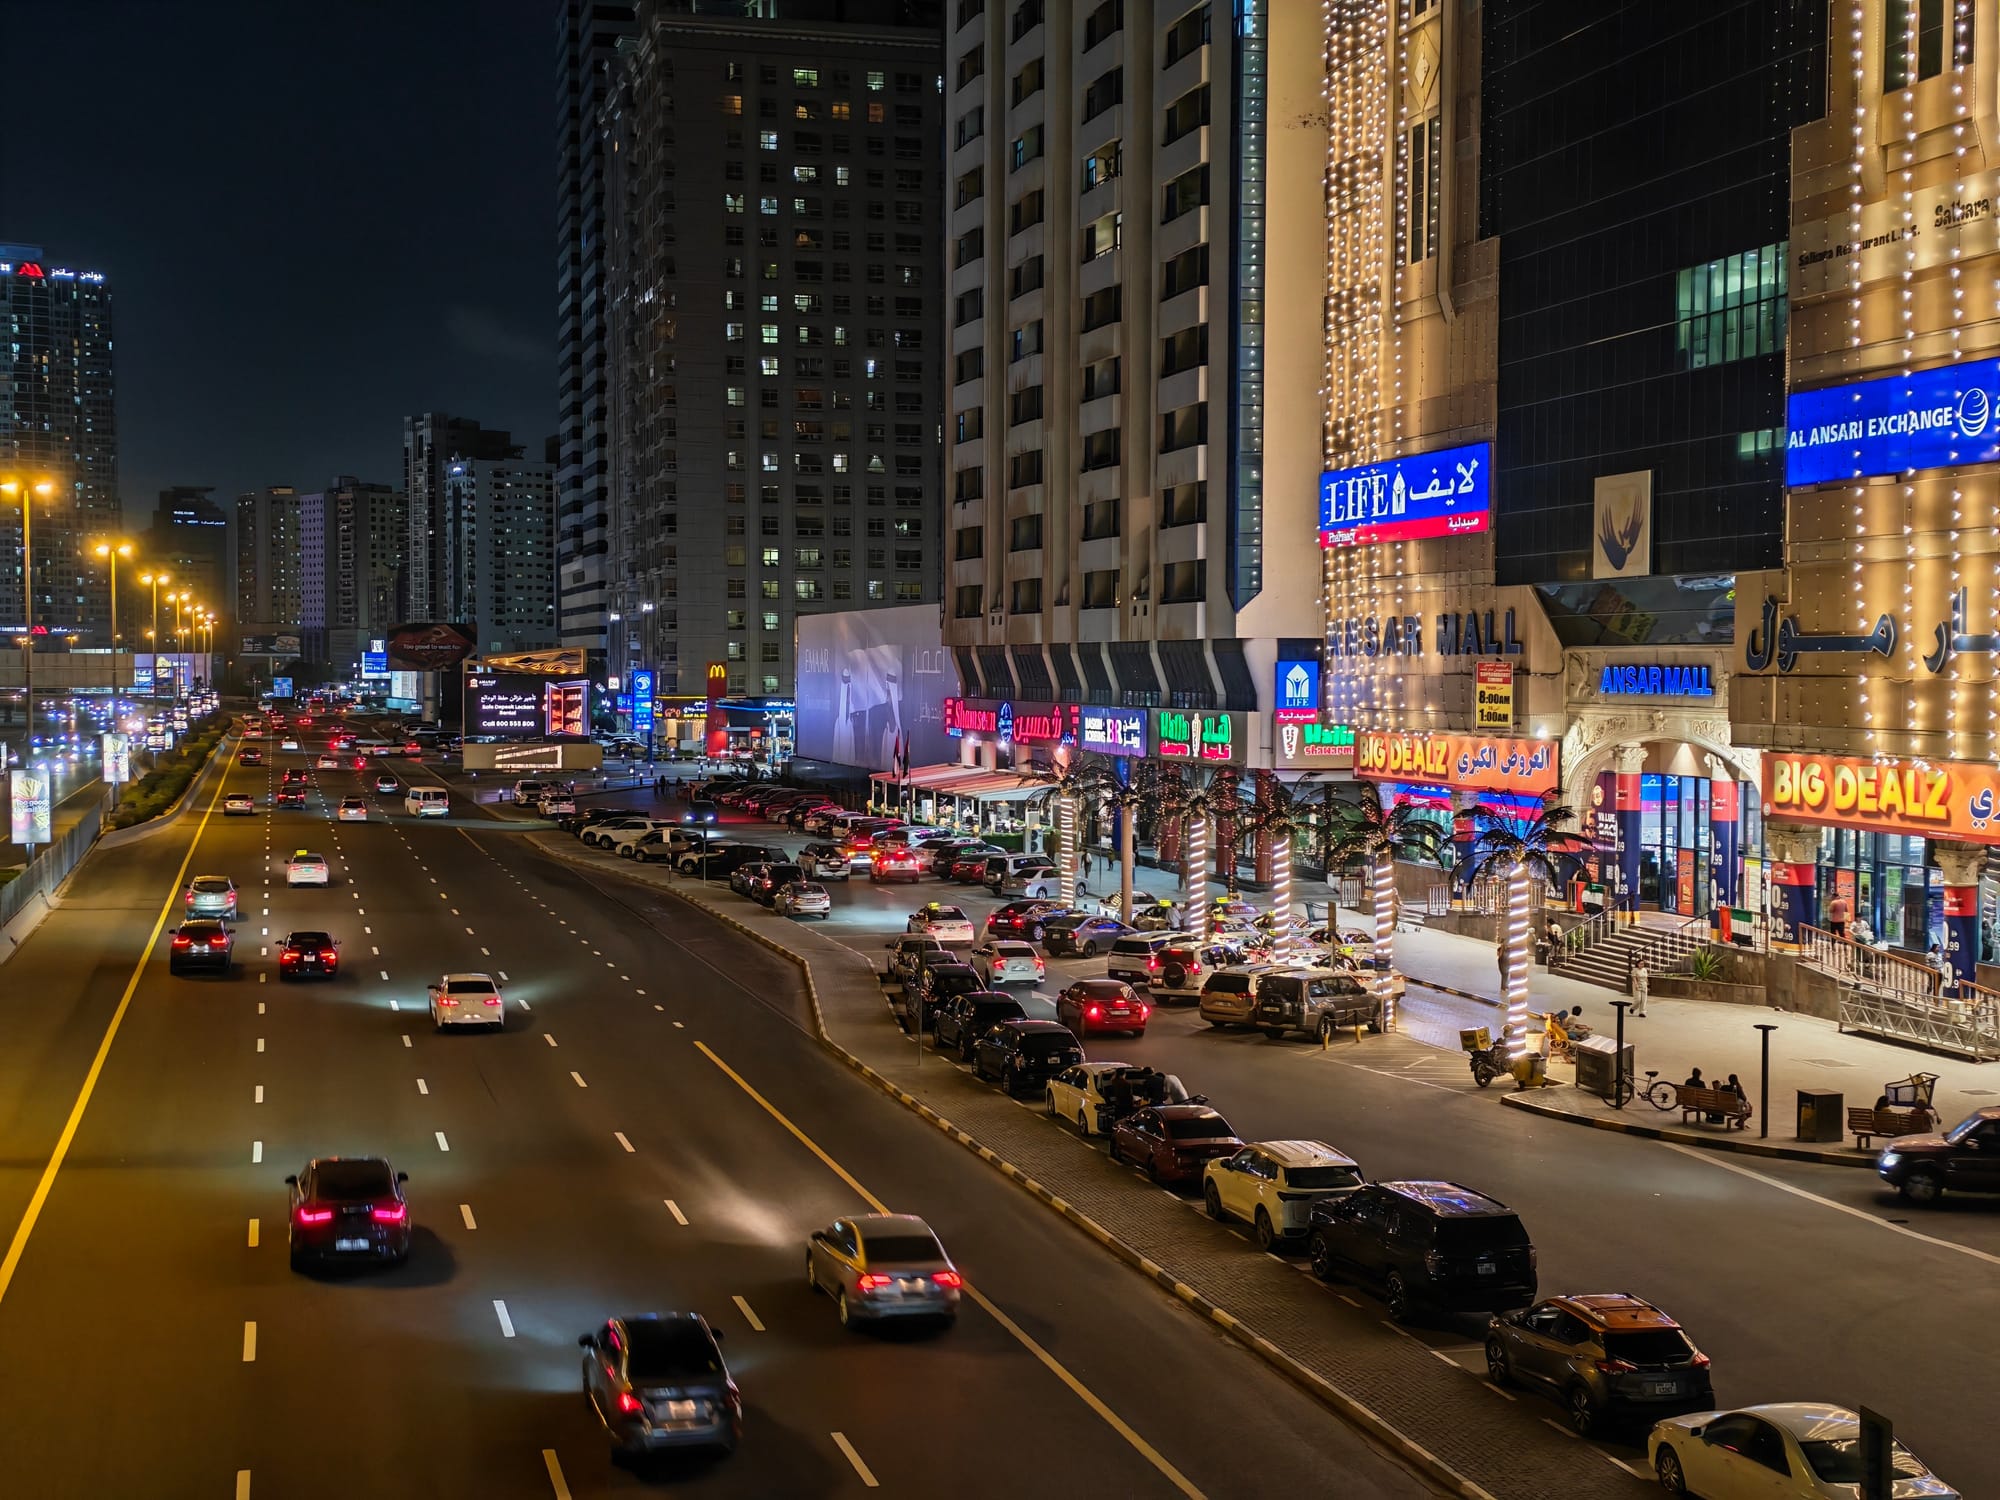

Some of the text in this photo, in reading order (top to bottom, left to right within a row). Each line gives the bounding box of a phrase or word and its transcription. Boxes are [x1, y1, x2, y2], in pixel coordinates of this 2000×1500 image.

[1788, 406, 1953, 449] AL ANSARI EXCHANGE
[1329, 473, 1389, 524] LIFE
[1409, 458, 1479, 507] لايف
[1448, 516, 1480, 532] صيدلية
[1326, 610, 1522, 657] ANSAR MALL
[1746, 594, 1897, 674] مول
[805, 648, 830, 673] EMAAR
[1600, 665, 1713, 697] ANSAR MALL
[955, 700, 996, 732] Shamseen
[1279, 711, 1316, 721] صيدلية
[1286, 698, 1310, 707] LIFE
[1013, 705, 1063, 744] شمسين
[1359, 736, 1449, 776] BIG DEALZ
[1500, 745, 1551, 777] العروض
[1773, 760, 1826, 808] BIG
[1834, 764, 1949, 821] DEALZ
